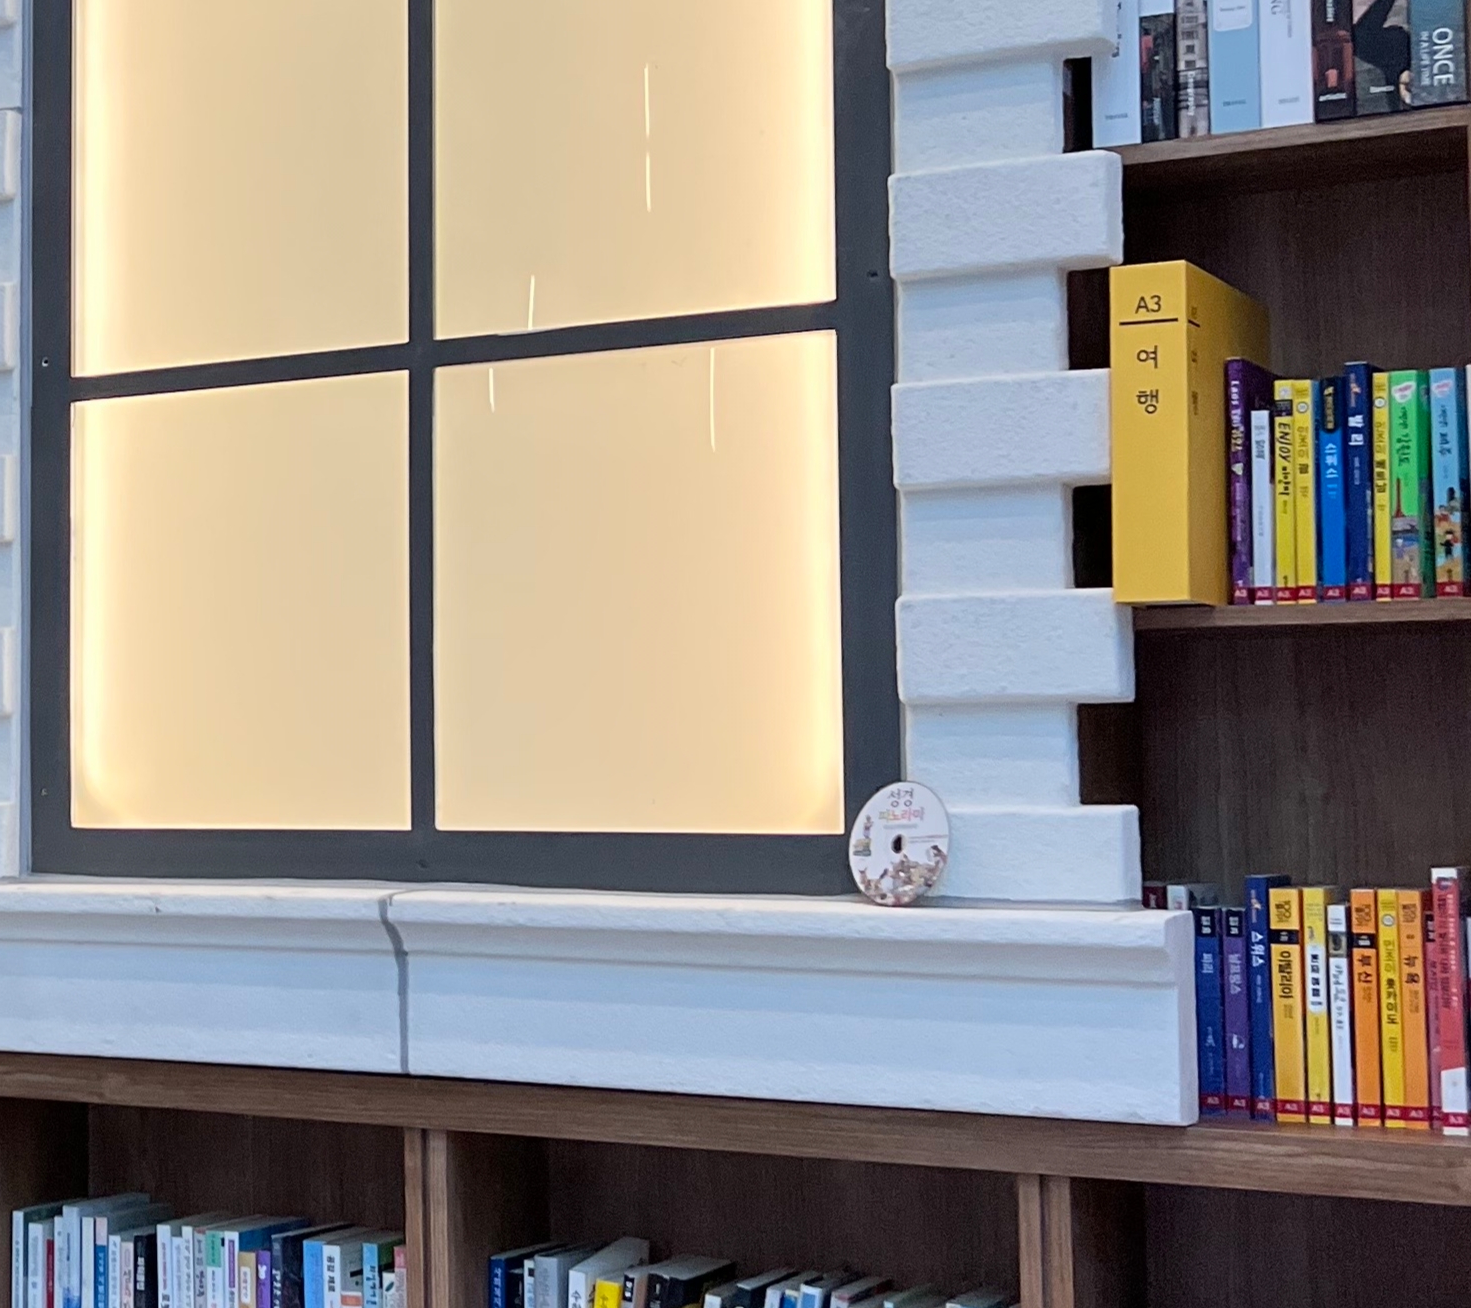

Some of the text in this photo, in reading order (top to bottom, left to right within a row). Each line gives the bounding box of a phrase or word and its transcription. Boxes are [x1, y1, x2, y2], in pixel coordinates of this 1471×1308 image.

[1432, 27, 1455, 87] ONCE
[1135, 295, 1162, 314] A3
[1278, 421, 1292, 462] ENJOY
[1278, 951, 1293, 999] 이탈리아
[1404, 954, 1420, 985] 뉴욕
